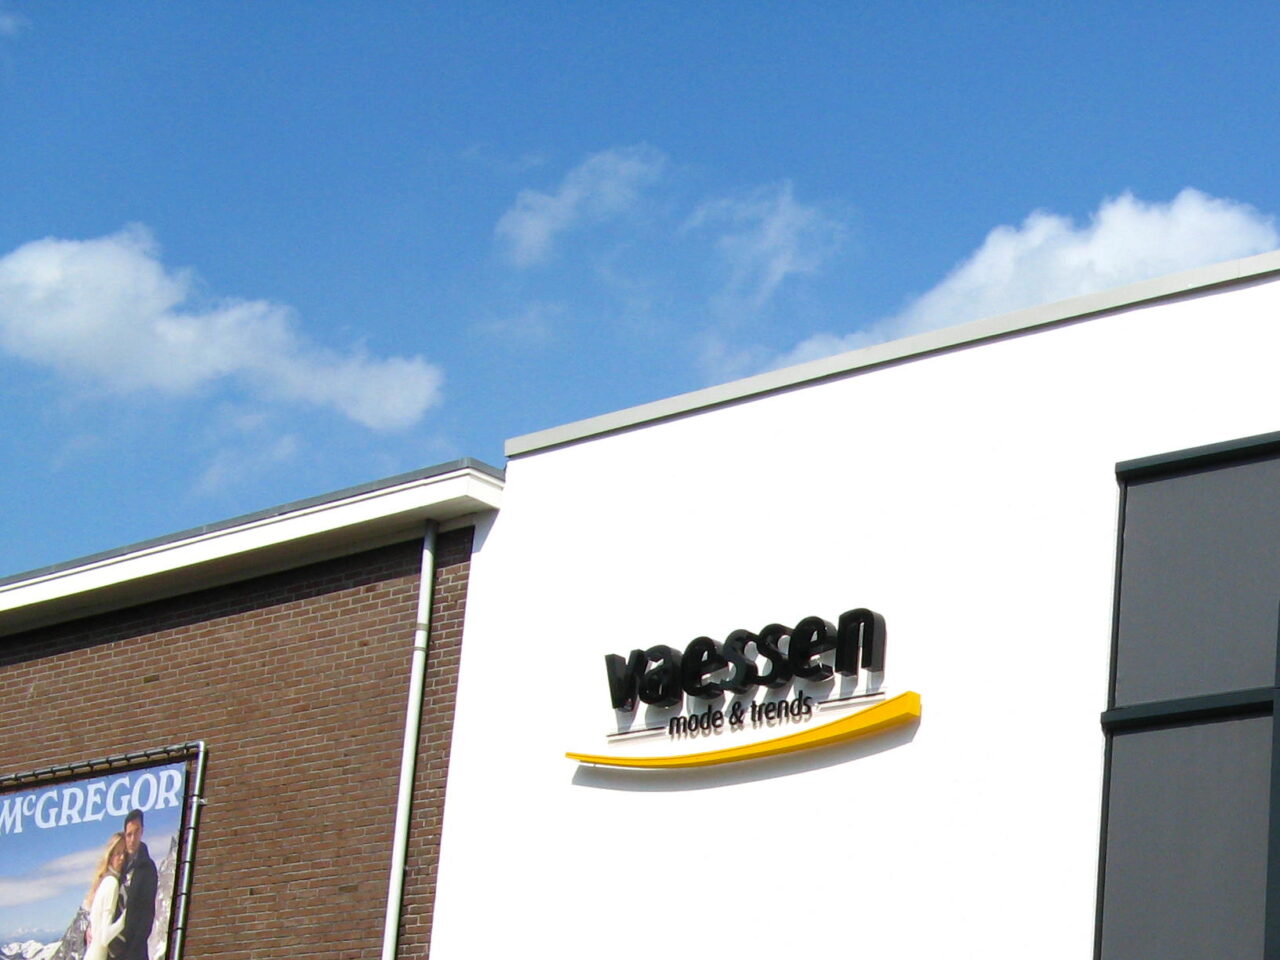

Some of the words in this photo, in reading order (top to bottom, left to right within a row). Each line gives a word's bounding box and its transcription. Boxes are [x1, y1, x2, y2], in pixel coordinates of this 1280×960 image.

[604, 608, 886, 712] vaessen
[668, 703, 723, 735] mode
[729, 701, 743, 725] &
[750, 690, 813, 722] trends
[0, 769, 182, 834] McGREGOR
